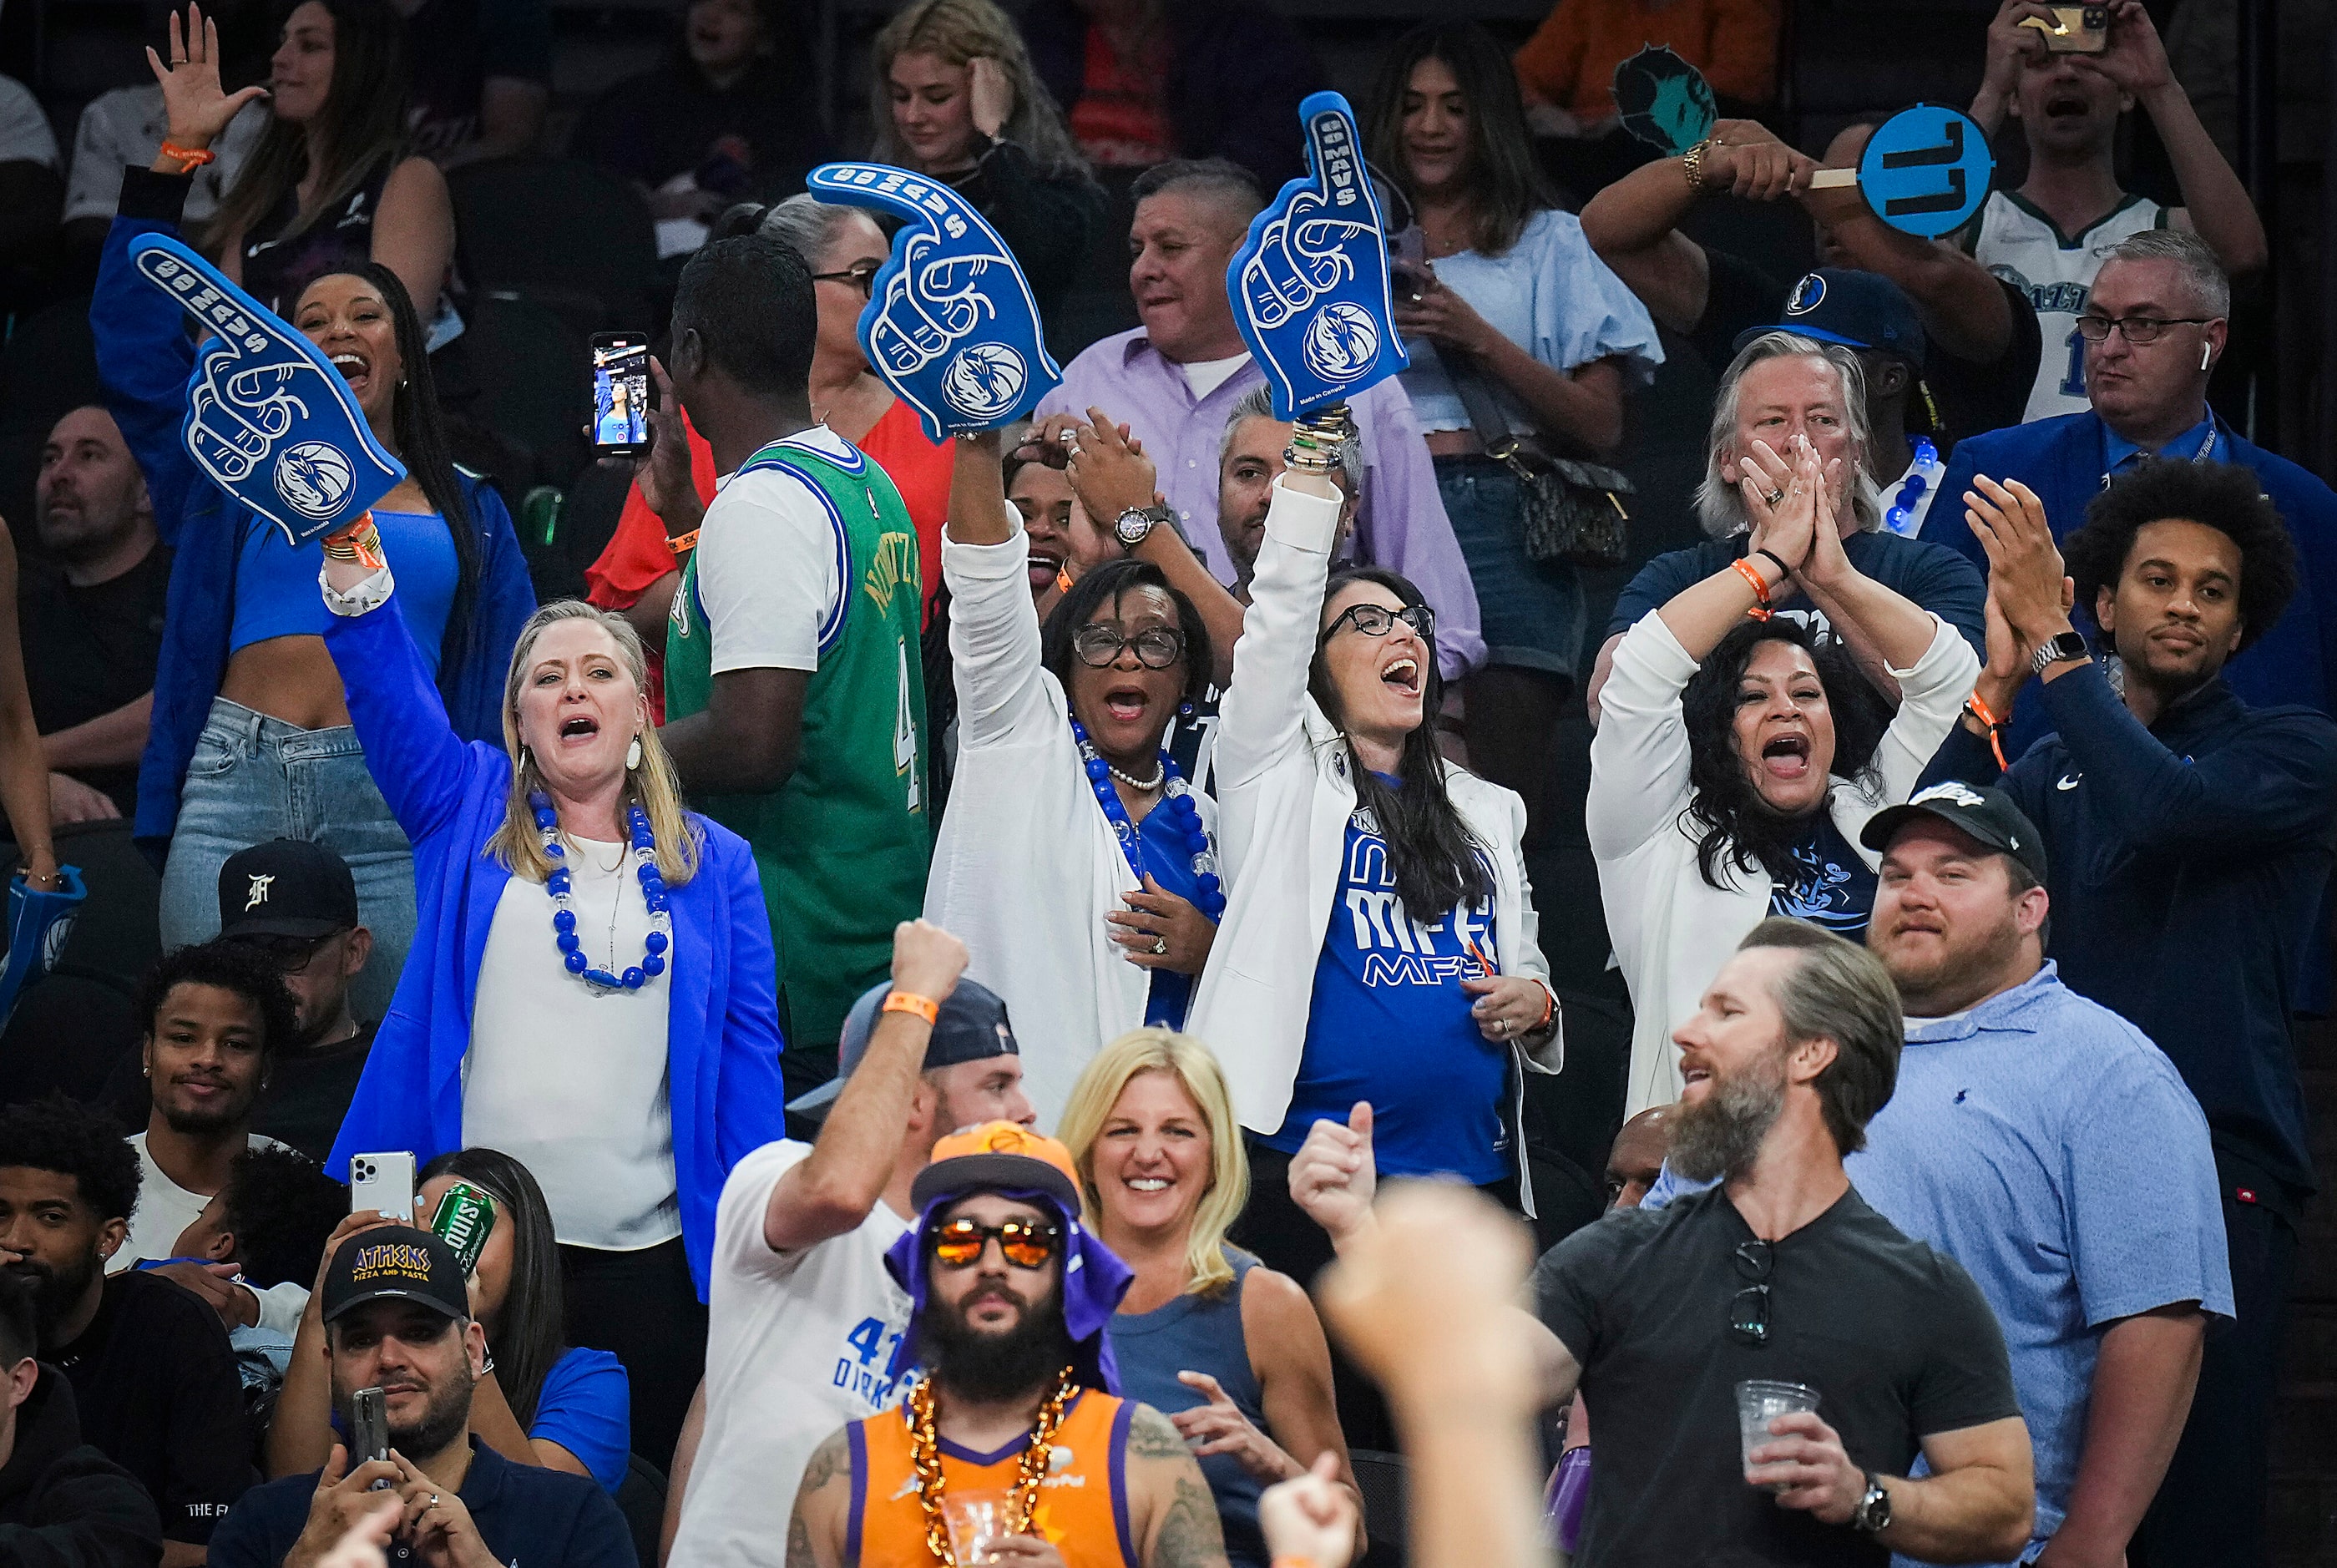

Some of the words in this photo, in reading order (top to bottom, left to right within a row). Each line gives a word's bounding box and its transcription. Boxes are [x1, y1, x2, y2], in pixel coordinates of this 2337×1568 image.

[1321, 120, 1345, 144] GO
[1324, 145, 1357, 206] MAVS
[1882, 121, 1967, 216] 11
[833, 168, 878, 185] GO
[877, 174, 968, 240] MAVS
[154, 260, 198, 292] GO
[190, 288, 269, 353] MAVS
[352, 1243, 432, 1274] ATHENS
[445, 1202, 480, 1259] QUIS
[353, 1270, 379, 1282] PIZZA
[402, 1270, 430, 1282] PASTA
[847, 1317, 904, 1377] 41
[833, 1358, 893, 1409] DIRK
[185, 1503, 213, 1516] THE
